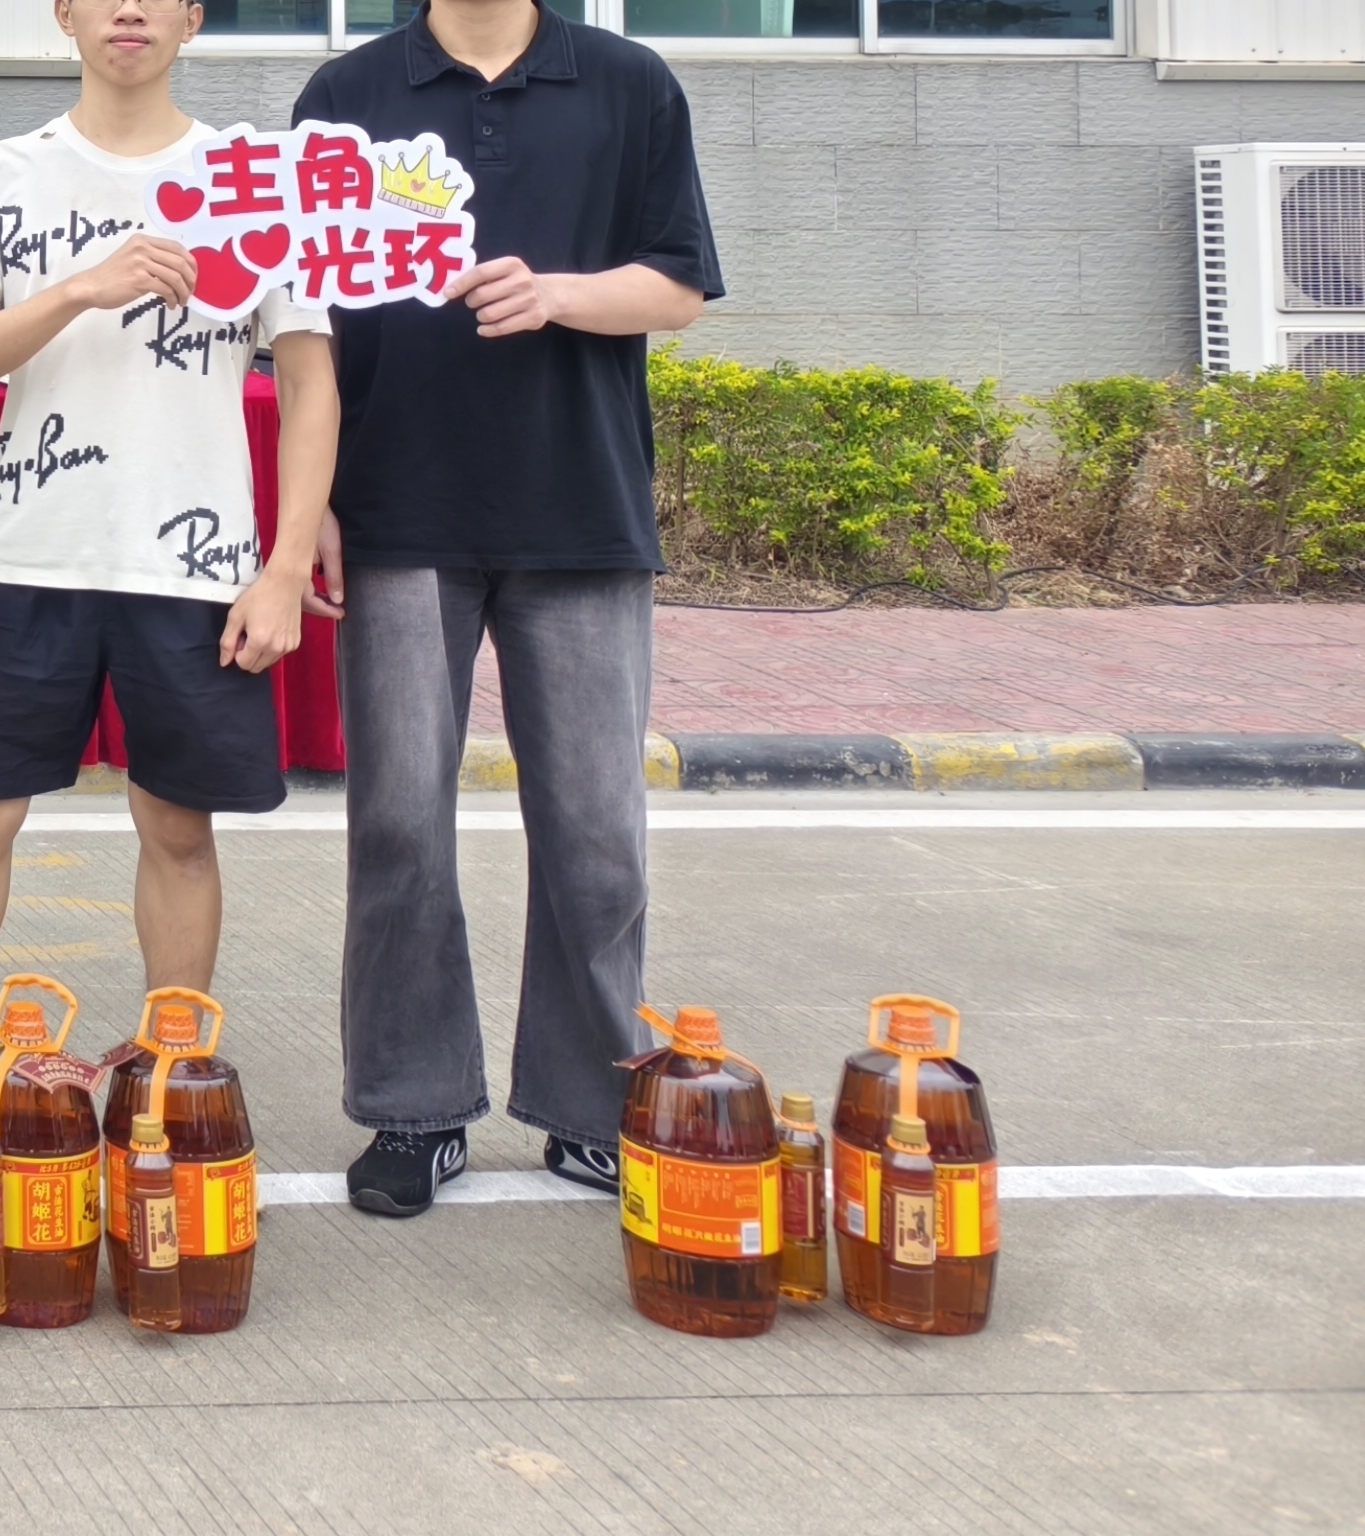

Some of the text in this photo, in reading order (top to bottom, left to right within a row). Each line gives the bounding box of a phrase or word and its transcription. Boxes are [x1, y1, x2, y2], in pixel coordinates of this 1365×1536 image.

[204, 133, 375, 218] 主角
[297, 221, 465, 300] 光环
[32, 1182, 52, 1242] 胡姬花
[54, 1183, 64, 1238] 古法花生油
[233, 1182, 246, 1242] 胡姬花
